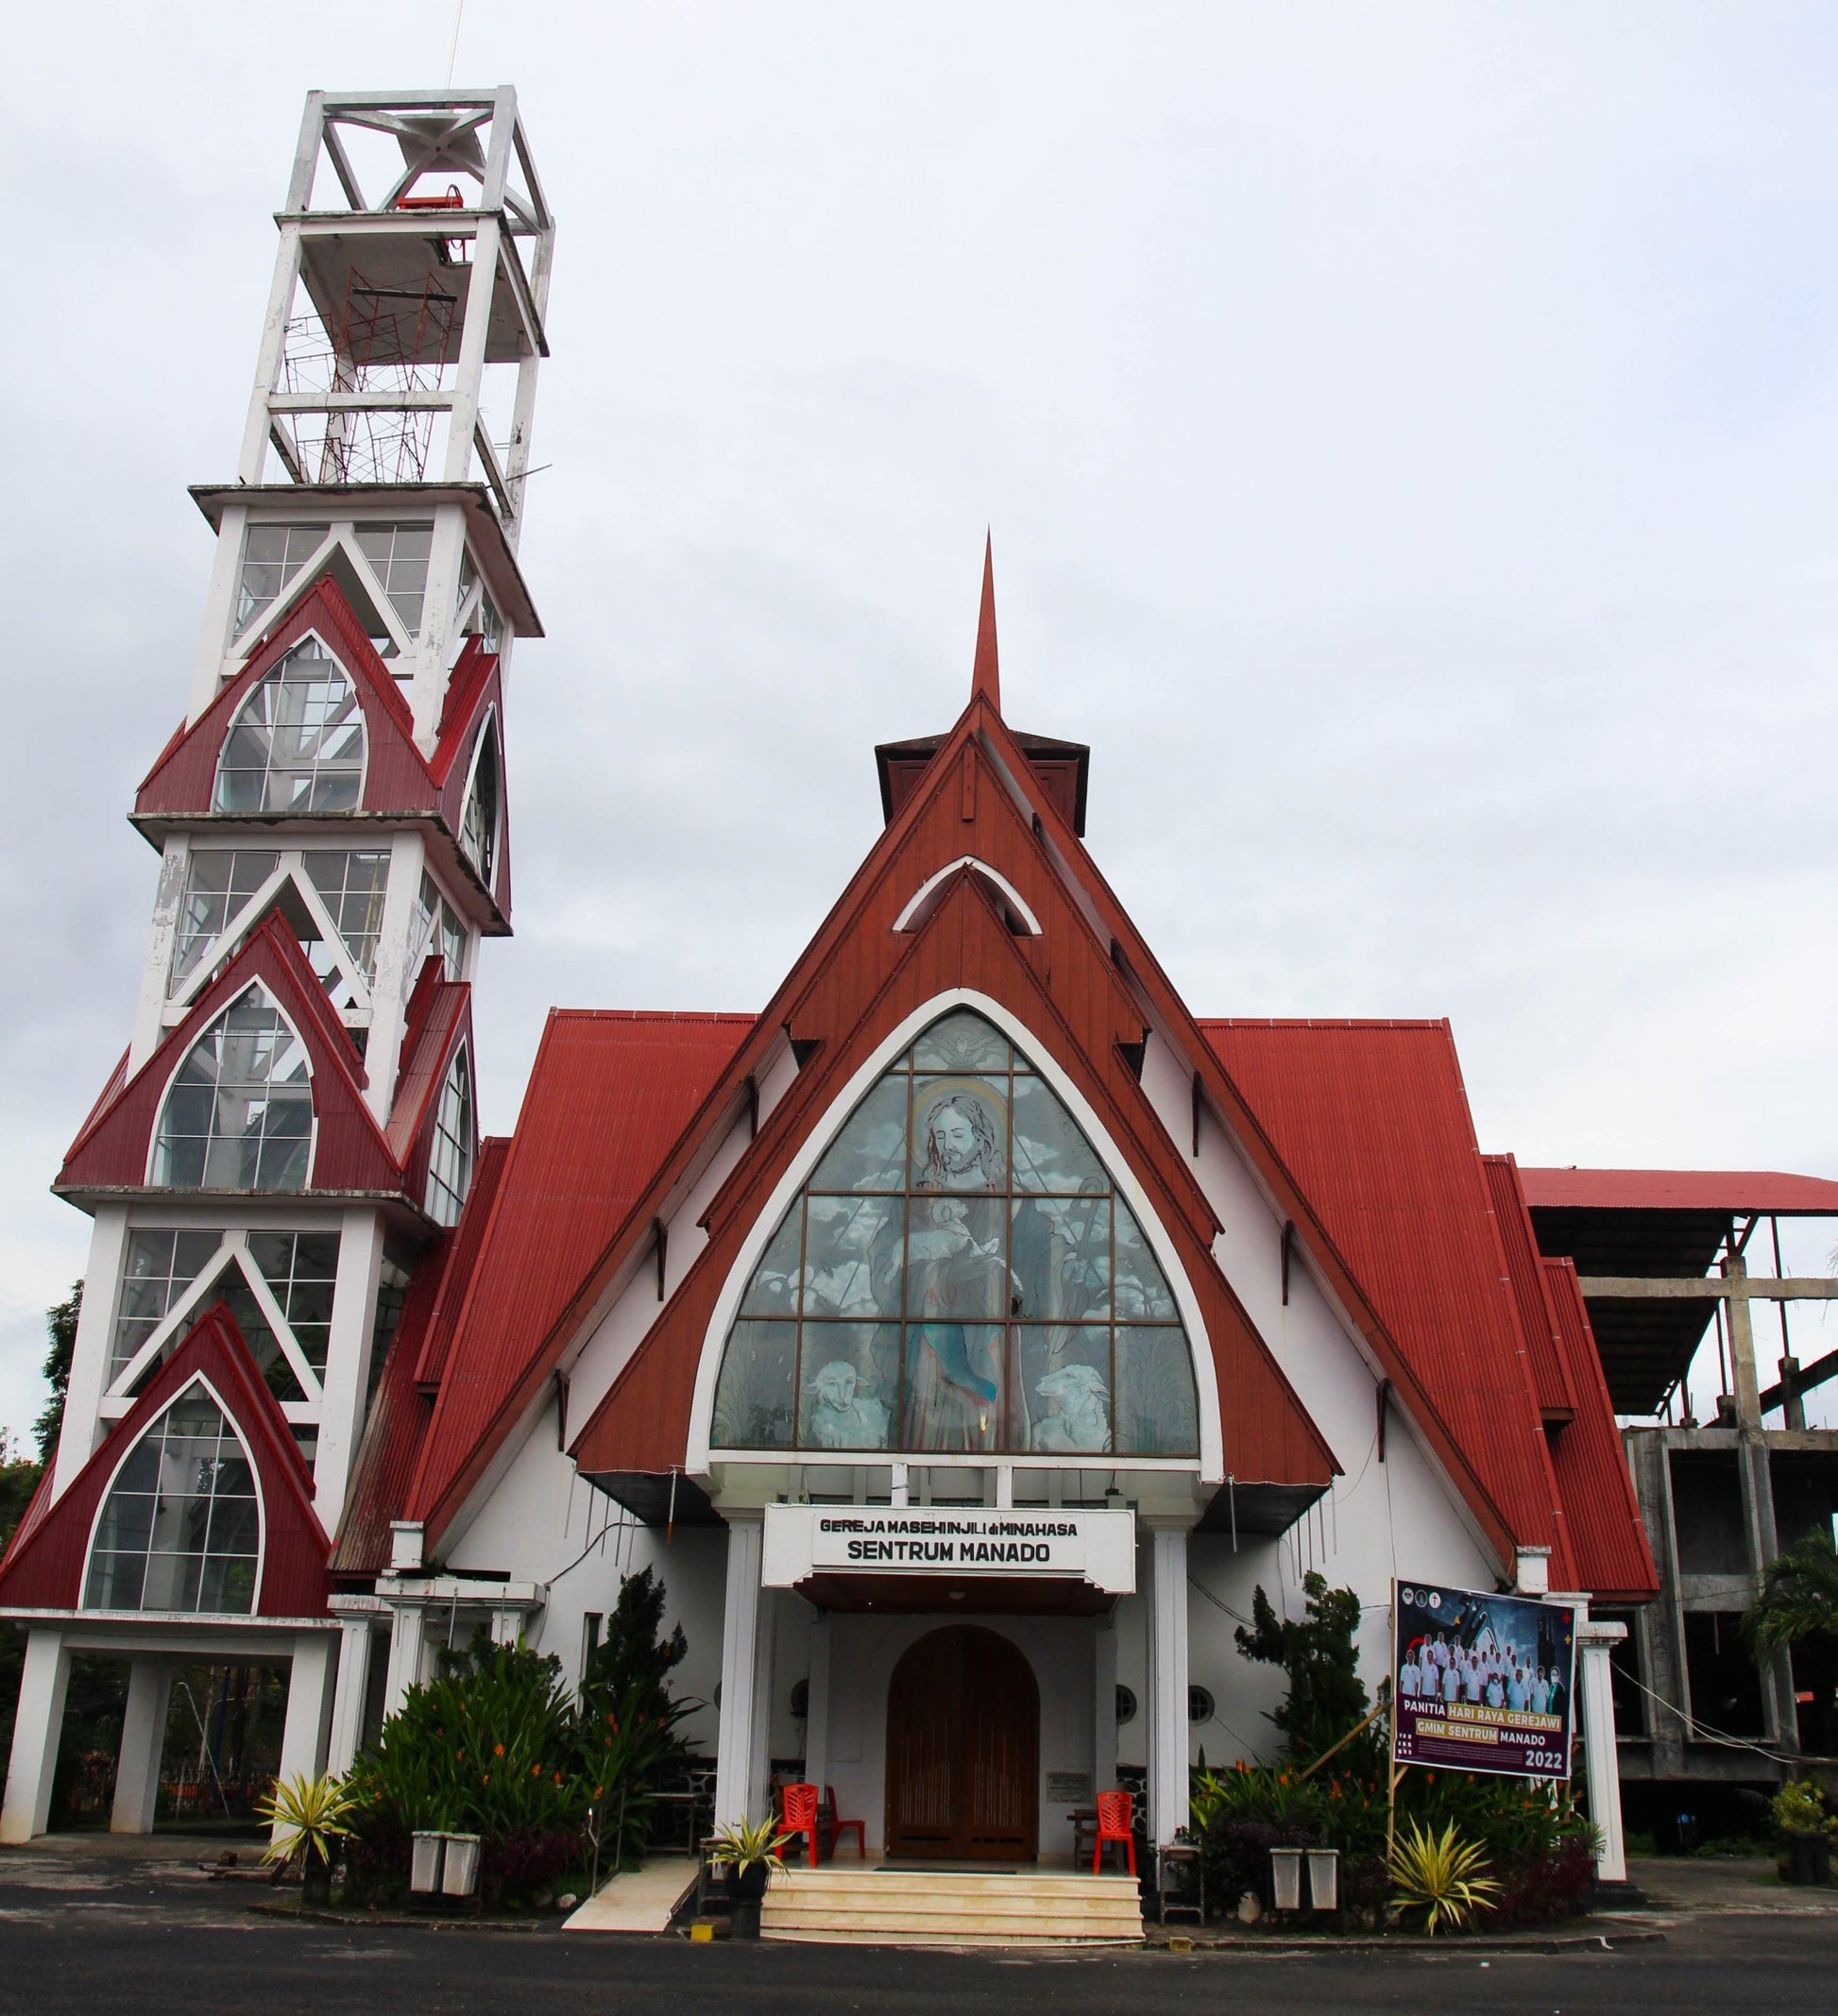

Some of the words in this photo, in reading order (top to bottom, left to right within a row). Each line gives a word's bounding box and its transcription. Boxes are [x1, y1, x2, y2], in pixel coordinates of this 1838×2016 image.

[820, 1518, 886, 1533] GEREJA
[887, 1520, 945, 1534] MASEHI
[947, 1521, 986, 1535] INJILI
[988, 1523, 998, 1535] di
[999, 1522, 1078, 1536] MINAHASA
[847, 1540, 954, 1561] SENTRUM
[960, 1542, 1050, 1563] MANADO
[1404, 1700, 1446, 1716] PANITIA
[1449, 1706, 1474, 1719] HARI
[1477, 1709, 1505, 1722] RAYA
[1507, 1714, 1560, 1728] GEREJAWI
[1418, 1721, 1445, 1735] GMIM
[1448, 1725, 1497, 1741] SENTRUM
[1500, 1731, 1545, 1746] MANADO
[1525, 1750, 1562, 1769] 2022
